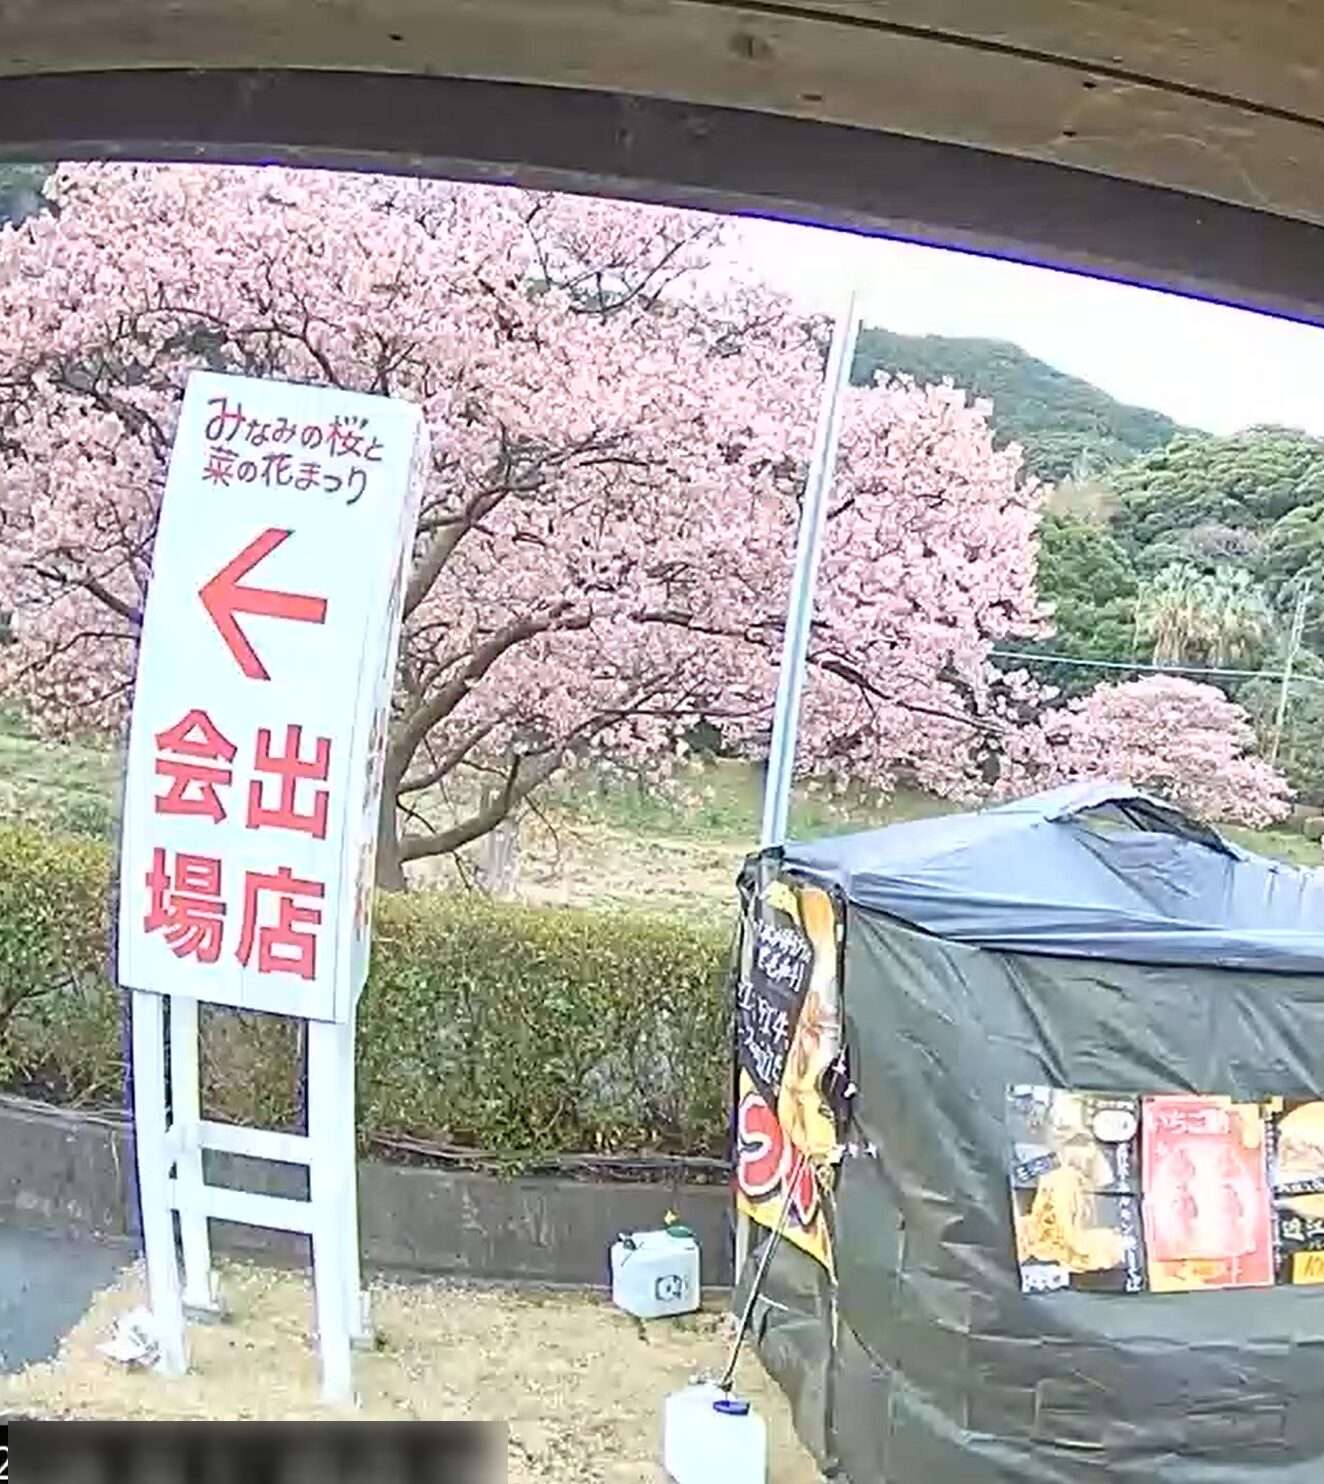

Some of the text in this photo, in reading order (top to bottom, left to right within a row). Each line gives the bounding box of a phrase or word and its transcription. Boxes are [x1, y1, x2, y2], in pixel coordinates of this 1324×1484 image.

[202, 445, 367, 505] 菜の花まつり
[205, 397, 384, 461] みなみの桜と
[143, 708, 237, 965] 会場
[235, 723, 332, 982] 出店
